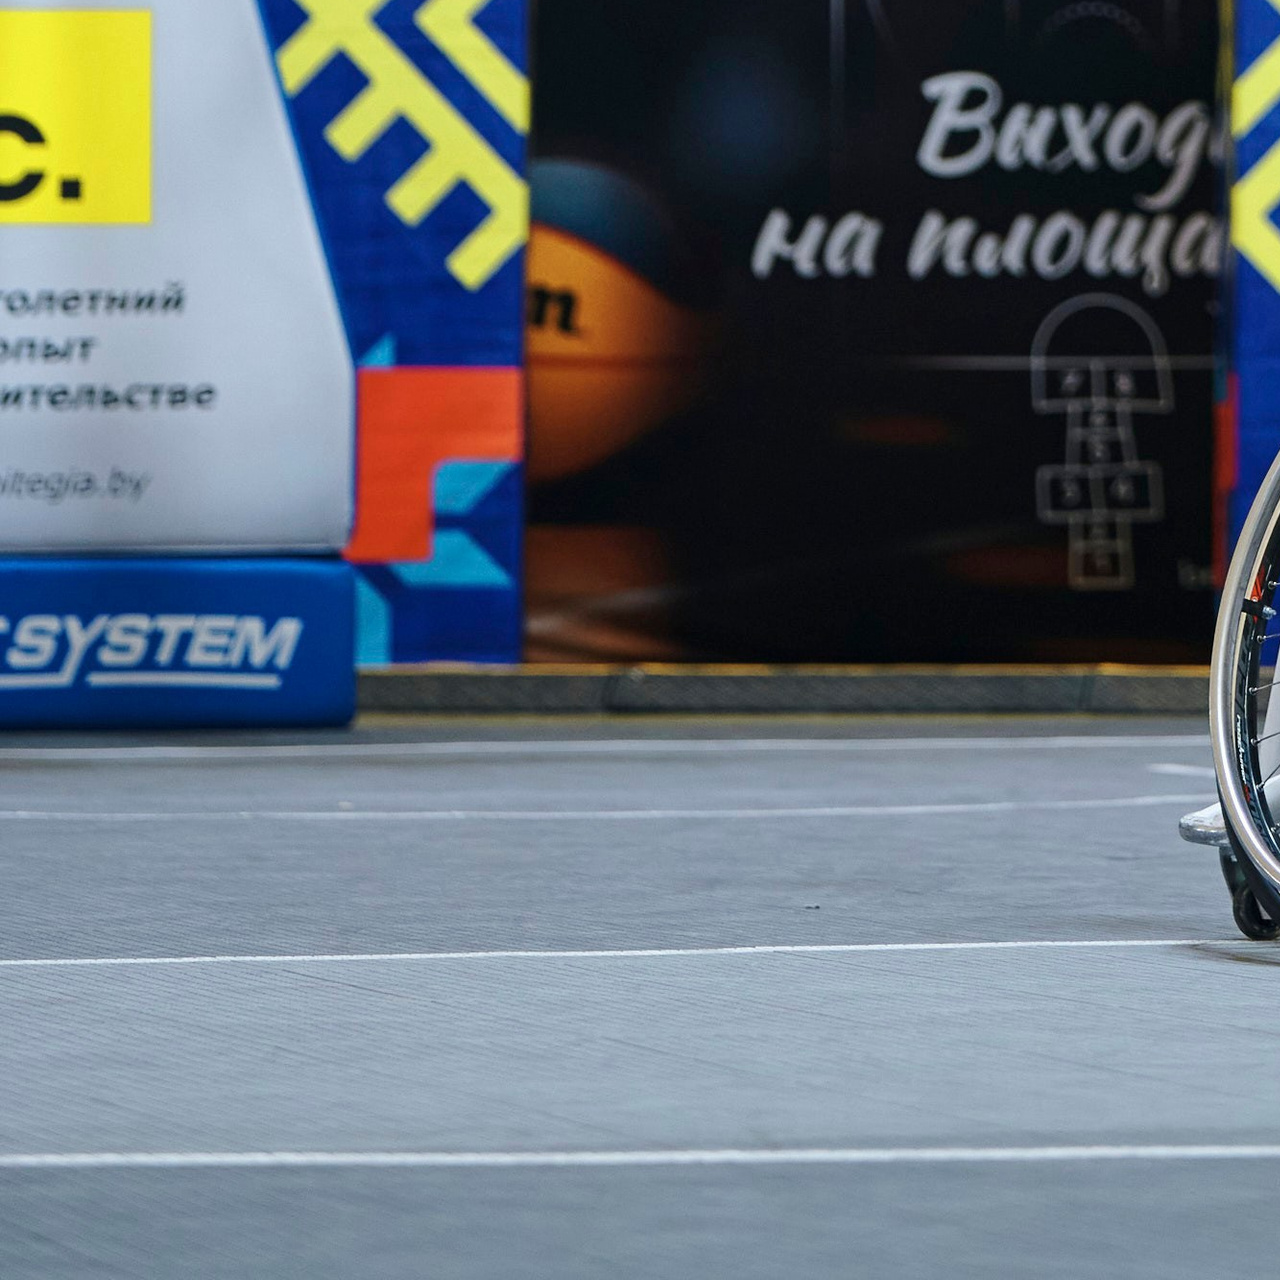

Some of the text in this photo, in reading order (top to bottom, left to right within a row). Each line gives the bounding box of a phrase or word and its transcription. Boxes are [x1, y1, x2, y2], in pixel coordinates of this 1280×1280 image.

[751, 207, 884, 280] на
[0, 281, 187, 317] олетний
[0, 614, 303, 688] SYSTEM
